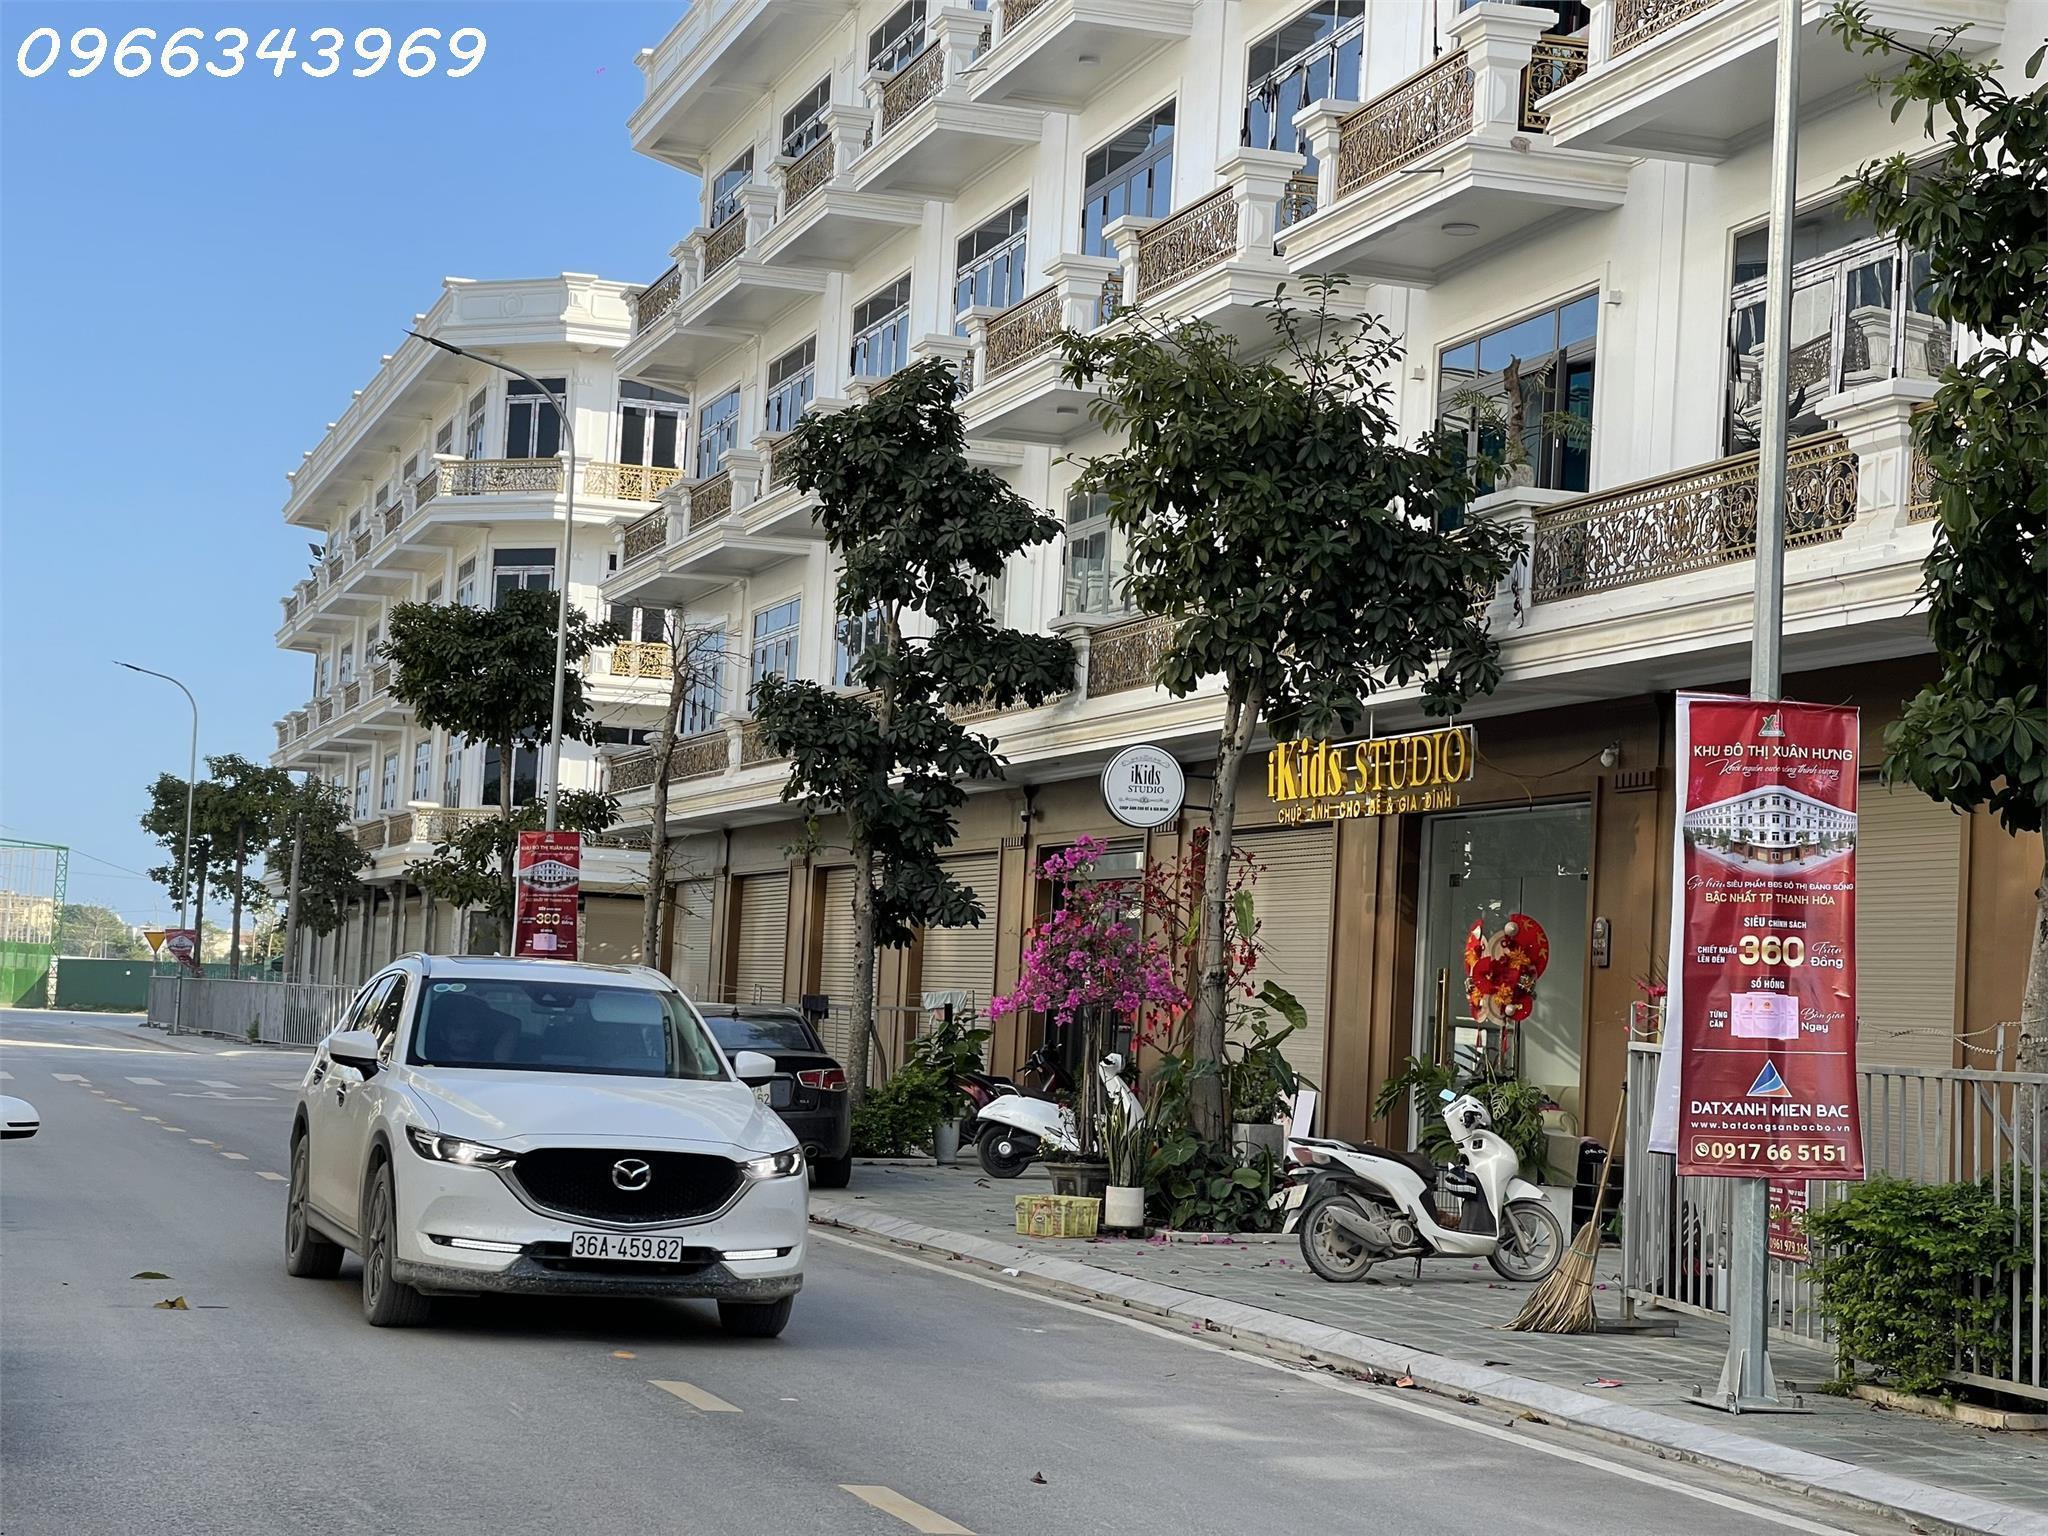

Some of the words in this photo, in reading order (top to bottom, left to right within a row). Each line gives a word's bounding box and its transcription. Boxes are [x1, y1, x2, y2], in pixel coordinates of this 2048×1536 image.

[1694, 745, 1720, 757] KHU
[1724, 742, 1744, 757] ĐÔ
[1748, 745, 1769, 760] THỊ
[1772, 743, 1807, 759] XUÂN
[1812, 747, 1853, 761] HƯNG
[1267, 737, 1344, 801] iKids
[1355, 728, 1467, 794] STUDIO
[1131, 764, 1161, 785] iKids
[1128, 785, 1164, 794] STUDIO
[1278, 806, 1303, 827] CHỤP
[1339, 800, 1360, 818] CHO
[1399, 795, 1418, 813] GIA
[1726, 879, 1743, 888] SIÊU
[1784, 881, 1794, 889] ĐÔ
[1796, 882, 1807, 891] THỊ
[1705, 890, 1727, 904] BẬC
[1730, 889, 1757, 903] NHẤT
[1759, 893, 1773, 903] TP
[1775, 893, 1809, 904] THANH
[1812, 893, 1835, 905] HÓA
[1744, 915, 1766, 928] SIÊU
[1789, 919, 1807, 929] SÁCH
[1738, 934, 1804, 968] 360
[1810, 955, 1844, 969] Đồng
[1801, 1022, 1829, 1033] Ngay
[1691, 1101, 1767, 1117] DATXANH
[1772, 1103, 1811, 1117] MIEN
[1817, 1104, 1849, 1118] BAC
[1691, 1121, 1850, 1133] www.batdongsanbacbo.vn
[1711, 1142, 1760, 1160] 0917
[1767, 1144, 1792, 1161] 66
[1798, 1145, 1846, 1162] 5151
[575, 1236, 679, 1260] 36A-459.82
